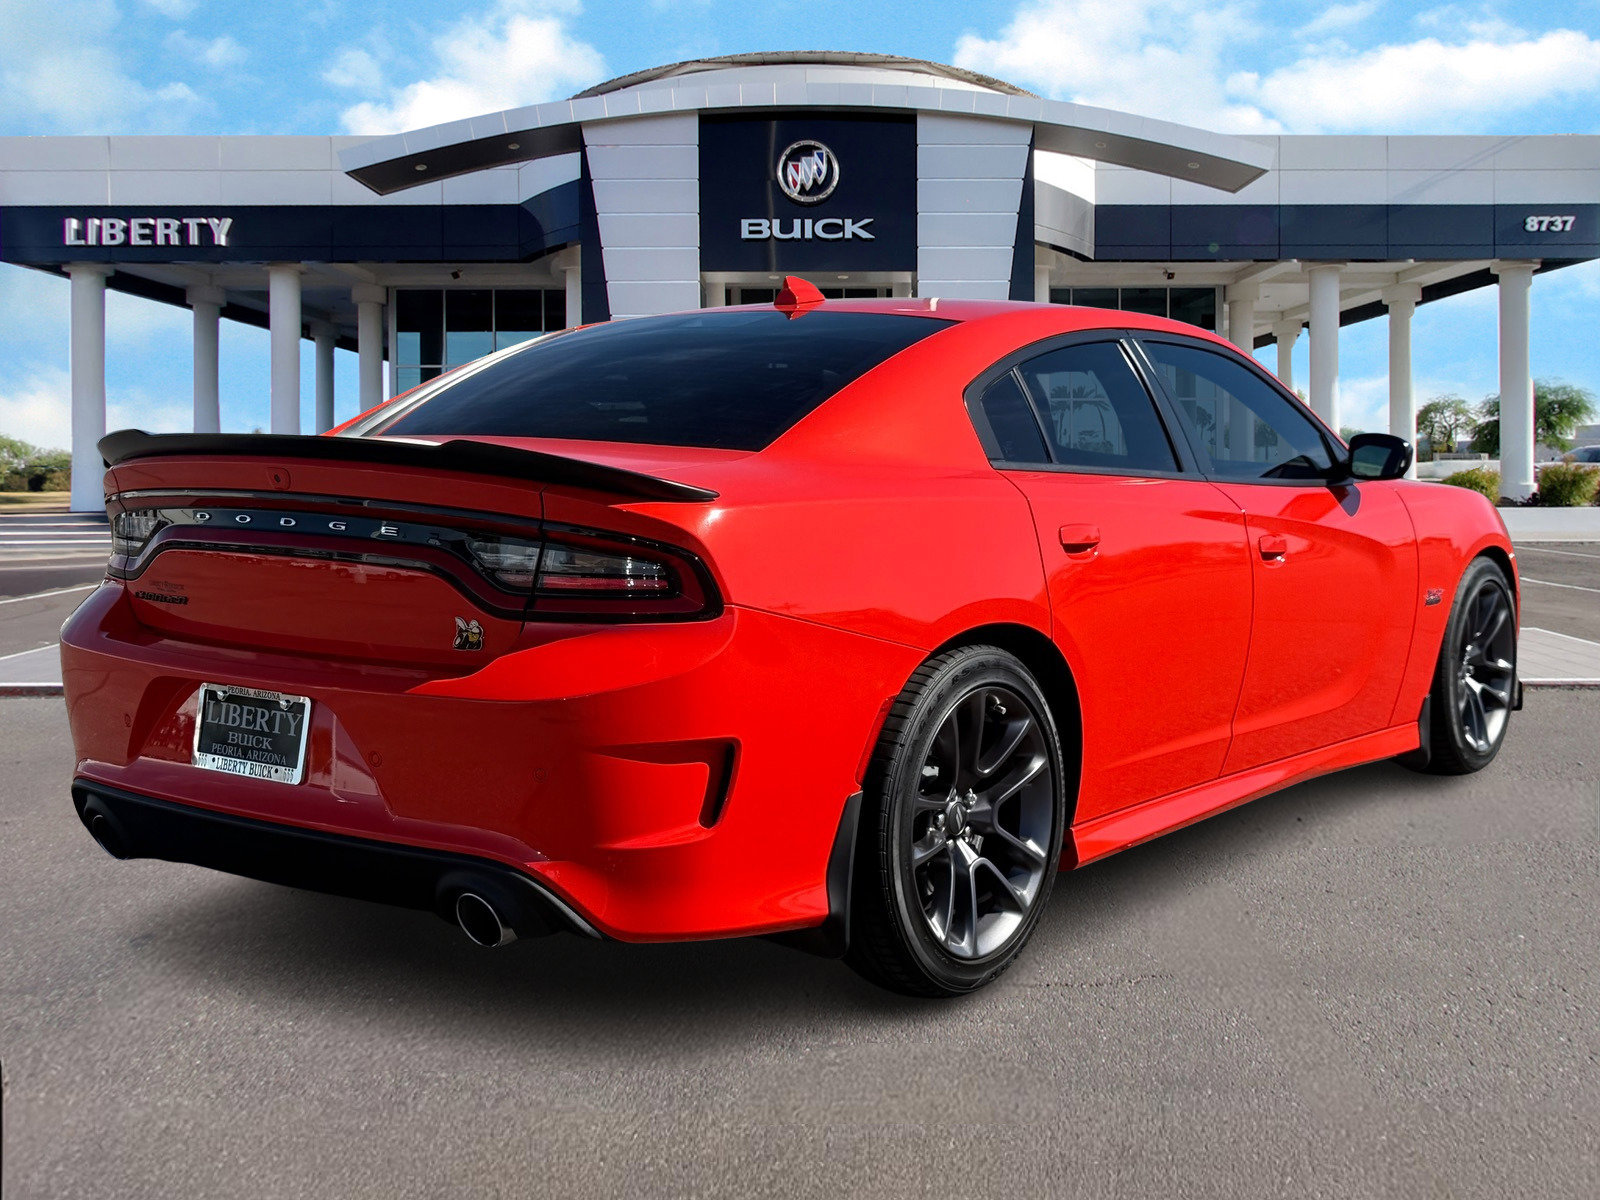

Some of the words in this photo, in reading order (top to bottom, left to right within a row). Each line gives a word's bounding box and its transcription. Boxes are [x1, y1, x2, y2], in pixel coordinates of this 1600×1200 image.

[63, 217, 233, 246] LIBERTY
[740, 218, 876, 240] BUICK
[1524, 215, 1576, 232] 8737
[196, 512, 399, 537] DODGE
[253, 688, 281, 700] ARIZONA
[206, 700, 302, 737] LIBERTY
[227, 731, 273, 750] BUICK
[246, 747, 287, 766] ARIZONA
[216, 757, 248, 774] LIBERTY
[248, 762, 273, 779] BUICK
